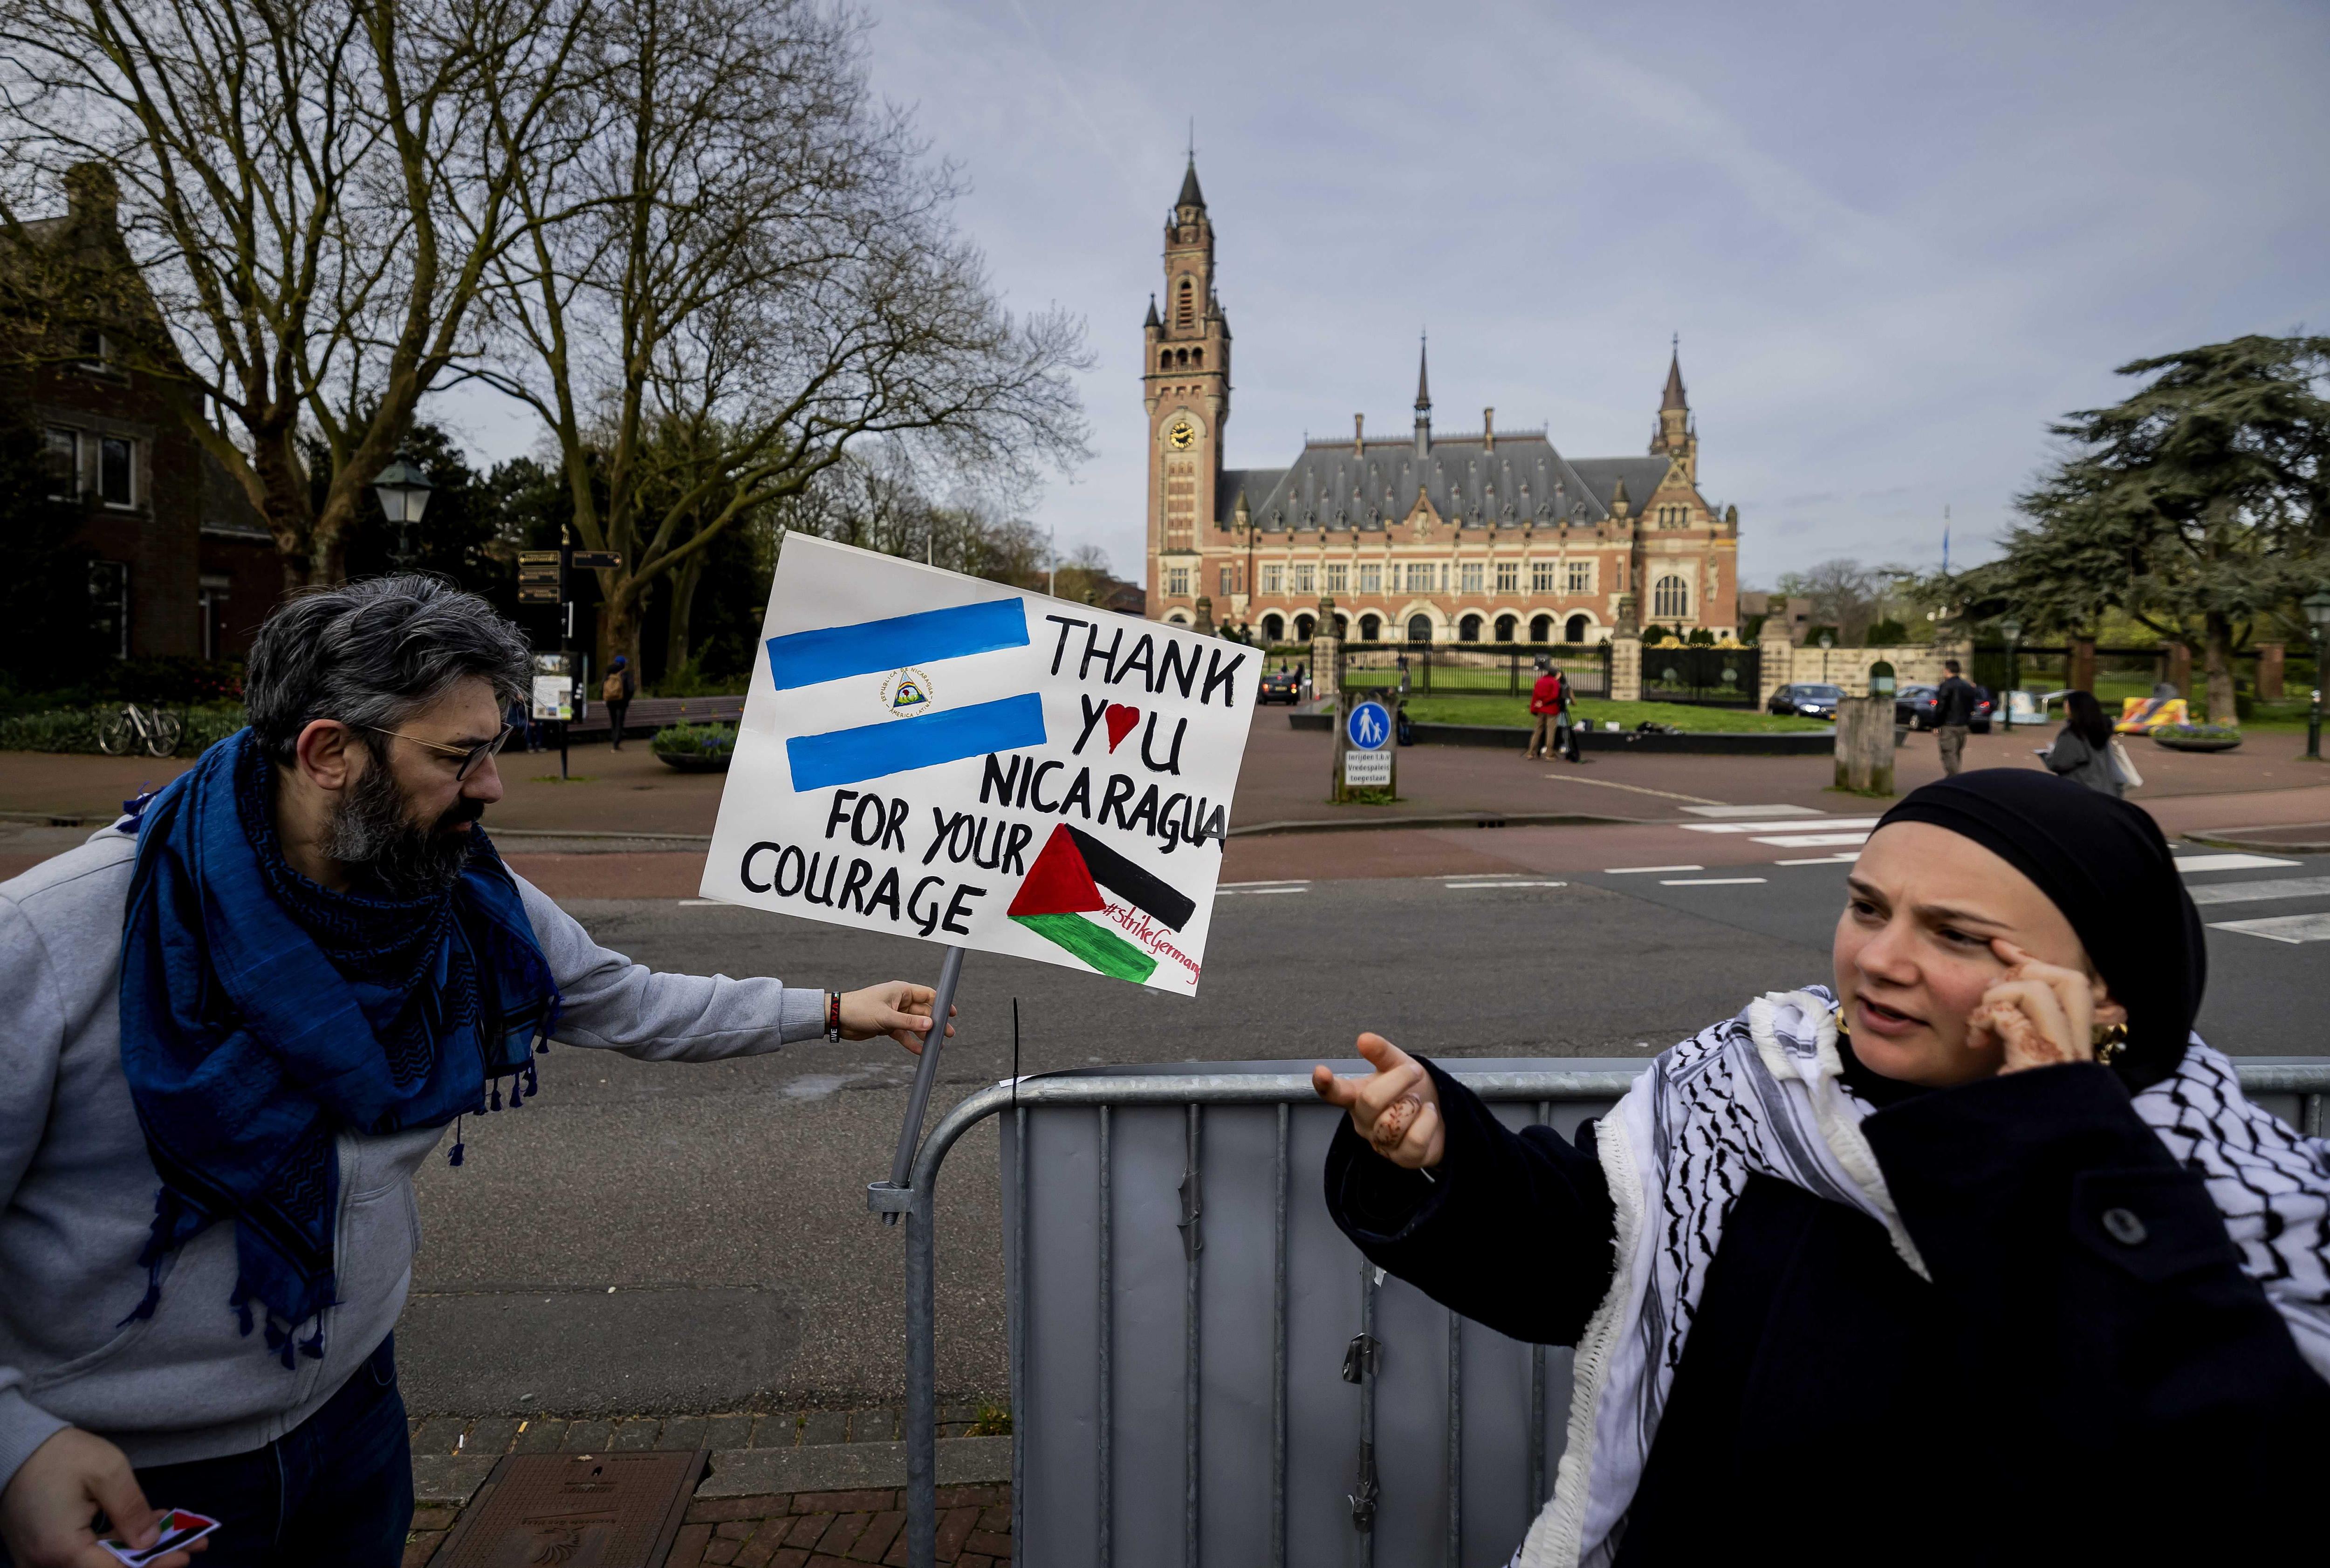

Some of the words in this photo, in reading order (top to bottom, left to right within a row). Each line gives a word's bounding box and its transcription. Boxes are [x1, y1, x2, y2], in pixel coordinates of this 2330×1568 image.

[1046, 615, 1246, 707] THANK
[889, 708, 913, 718] AMERICA
[825, 789, 909, 853] FOR
[922, 807, 1032, 876] YOUR
[980, 753, 1226, 854] NICARAGUA
[741, 842, 987, 937] COURAGE
